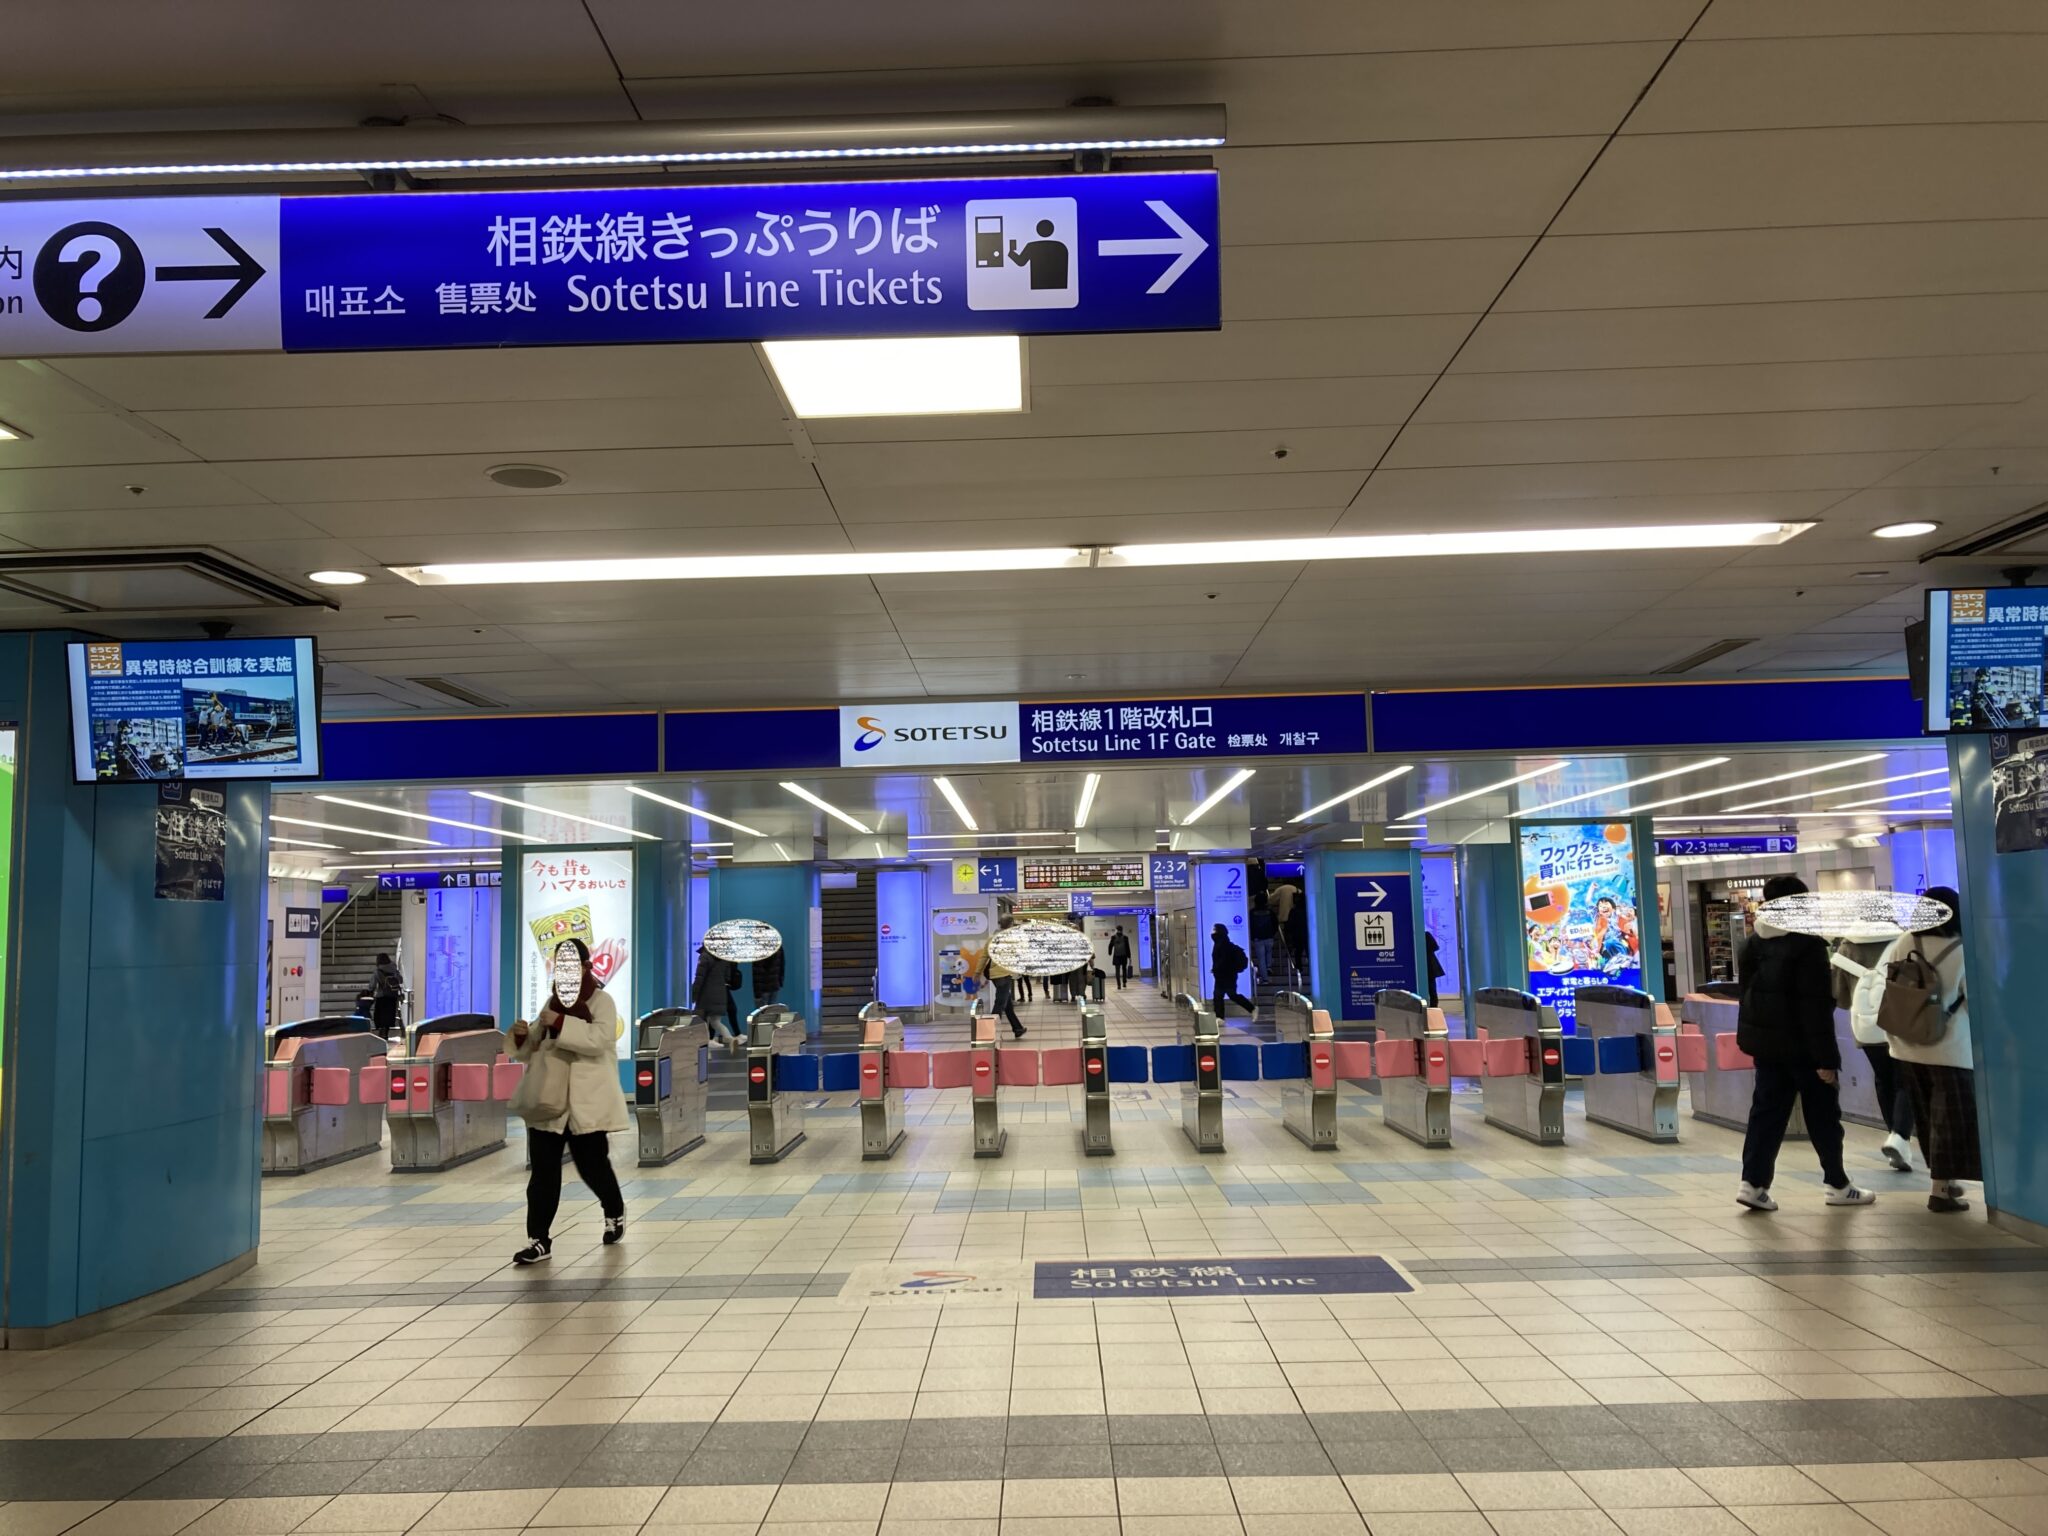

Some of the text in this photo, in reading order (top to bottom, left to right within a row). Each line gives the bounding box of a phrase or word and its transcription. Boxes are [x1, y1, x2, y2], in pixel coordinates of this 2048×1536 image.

[487, 203, 942, 267] 相鉄線きっぷうりば
[435, 280, 537, 316] 售票处
[567, 268, 943, 312] Sotetsu Line Tickets
[305, 285, 405, 319] 매표소
[1953, 609, 1984, 617] トレイン
[90, 662, 121, 670] トレイン
[125, 656, 293, 676] 異常時総合訓練を実施
[1031, 705, 1213, 733] 相鉄線1階改札口
[894, 725, 1007, 742] SOTETSU
[1031, 731, 1216, 753] Sotetsu Line 1F Gate
[1227, 733, 1268, 748] 检票处
[1279, 731, 1320, 746] 개찰구
[530, 858, 591, 877] 今も昔も
[993, 864, 1000, 876] 1
[1539, 853, 1619, 880] 買いに行こう。
[538, 878, 627, 892] ハマるおいしさ
[1226, 867, 1242, 889] 2
[434, 890, 443, 912] 1
[1070, 1265, 1238, 1279] 相鉄線
[1070, 1275, 1318, 1289] Sotetsu Line
